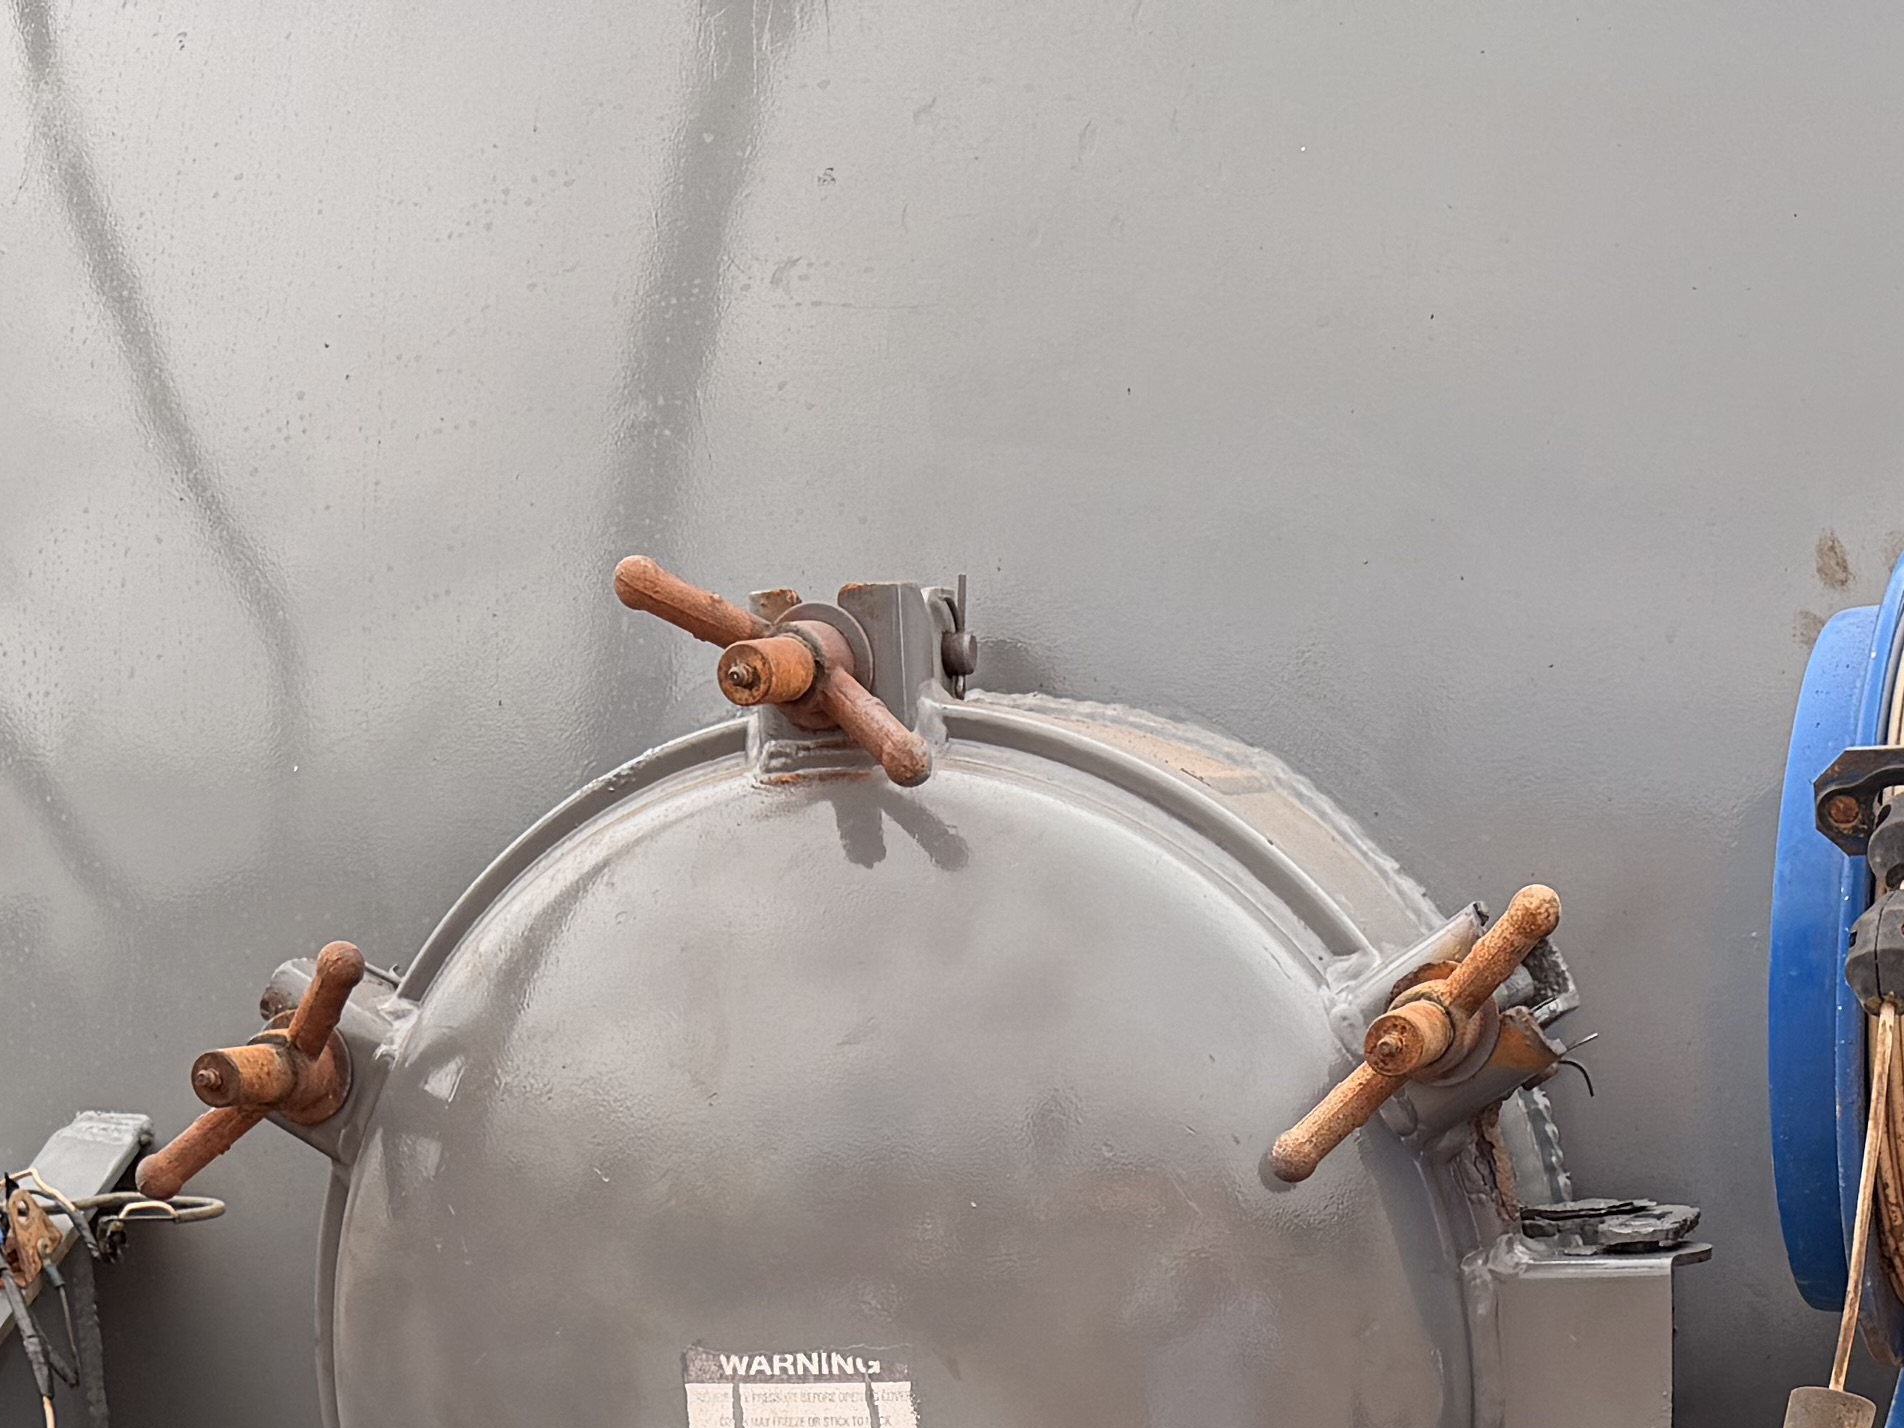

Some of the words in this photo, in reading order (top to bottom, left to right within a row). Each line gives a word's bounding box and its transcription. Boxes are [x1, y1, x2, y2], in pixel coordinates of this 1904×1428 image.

[719, 1352, 881, 1375] WARNING
[750, 1416, 770, 1427] MAY
[807, 1416, 821, 1427] OR
[823, 1416, 850, 1427] STICK
[852, 1416, 864, 1427] TO
